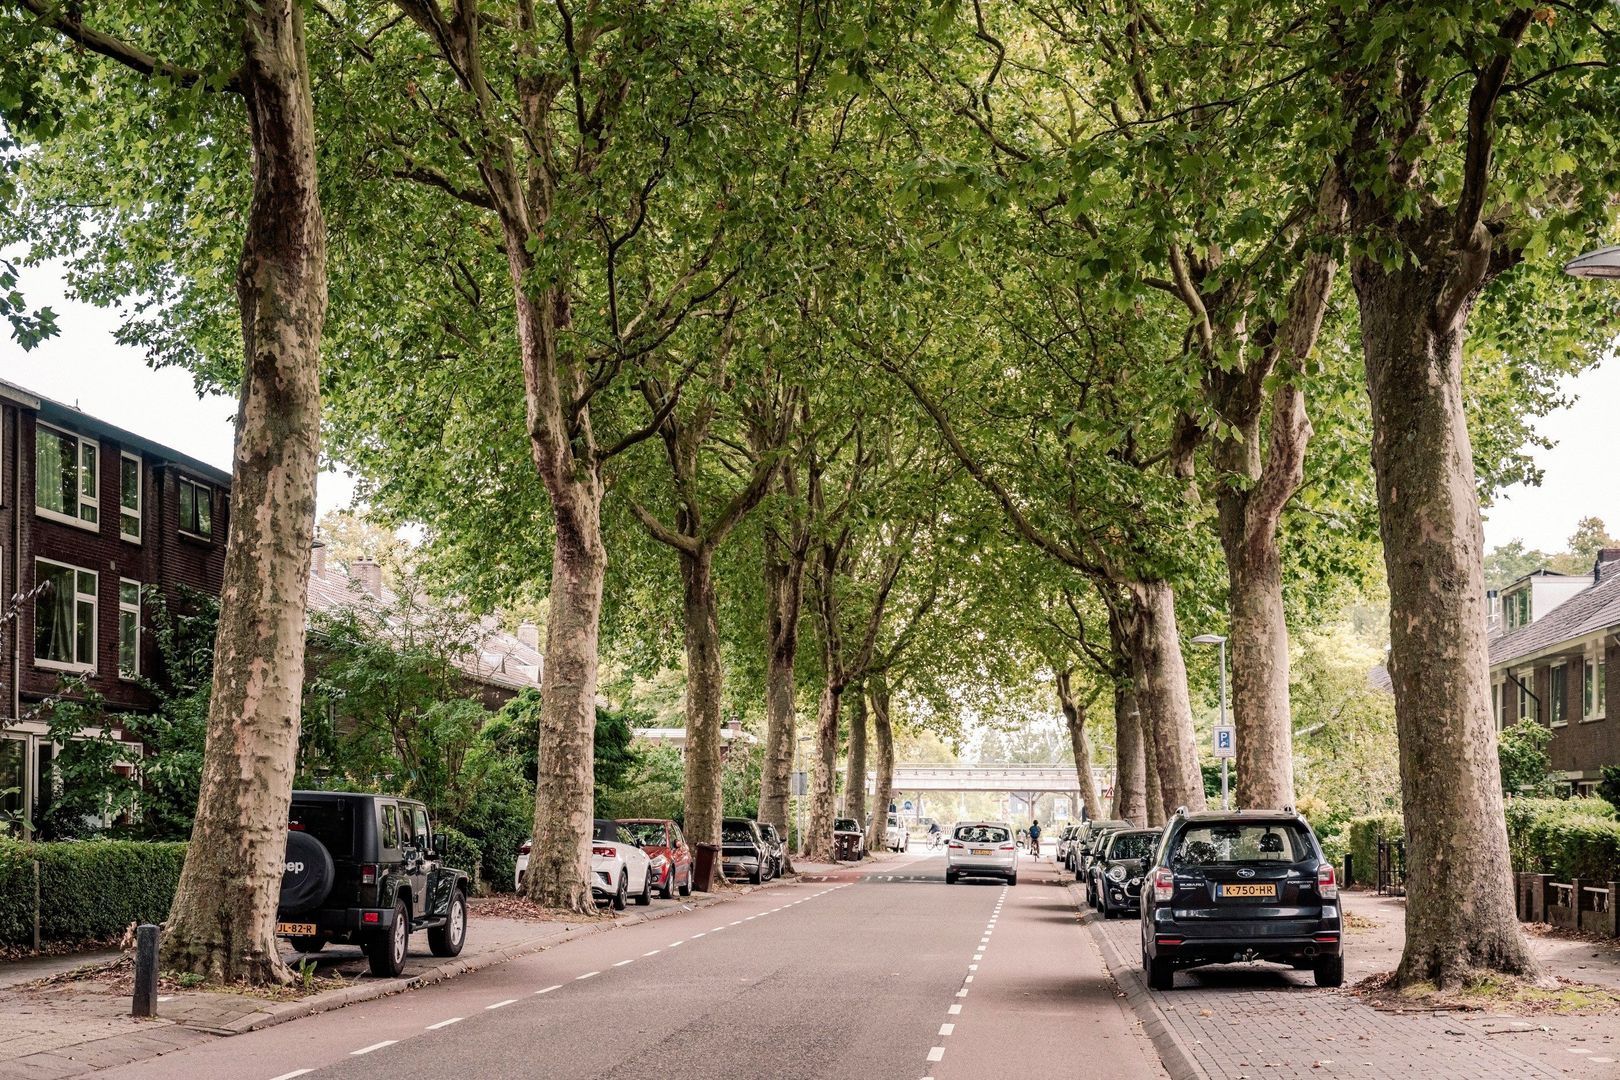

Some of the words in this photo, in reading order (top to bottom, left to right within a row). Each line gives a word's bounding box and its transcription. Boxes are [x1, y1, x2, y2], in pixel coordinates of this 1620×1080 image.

[1221, 732, 1228, 742] P
[283, 861, 304, 874] ep
[1226, 886, 1273, 895] K-750-HR
[277, 924, 312, 934] JL-82-R
